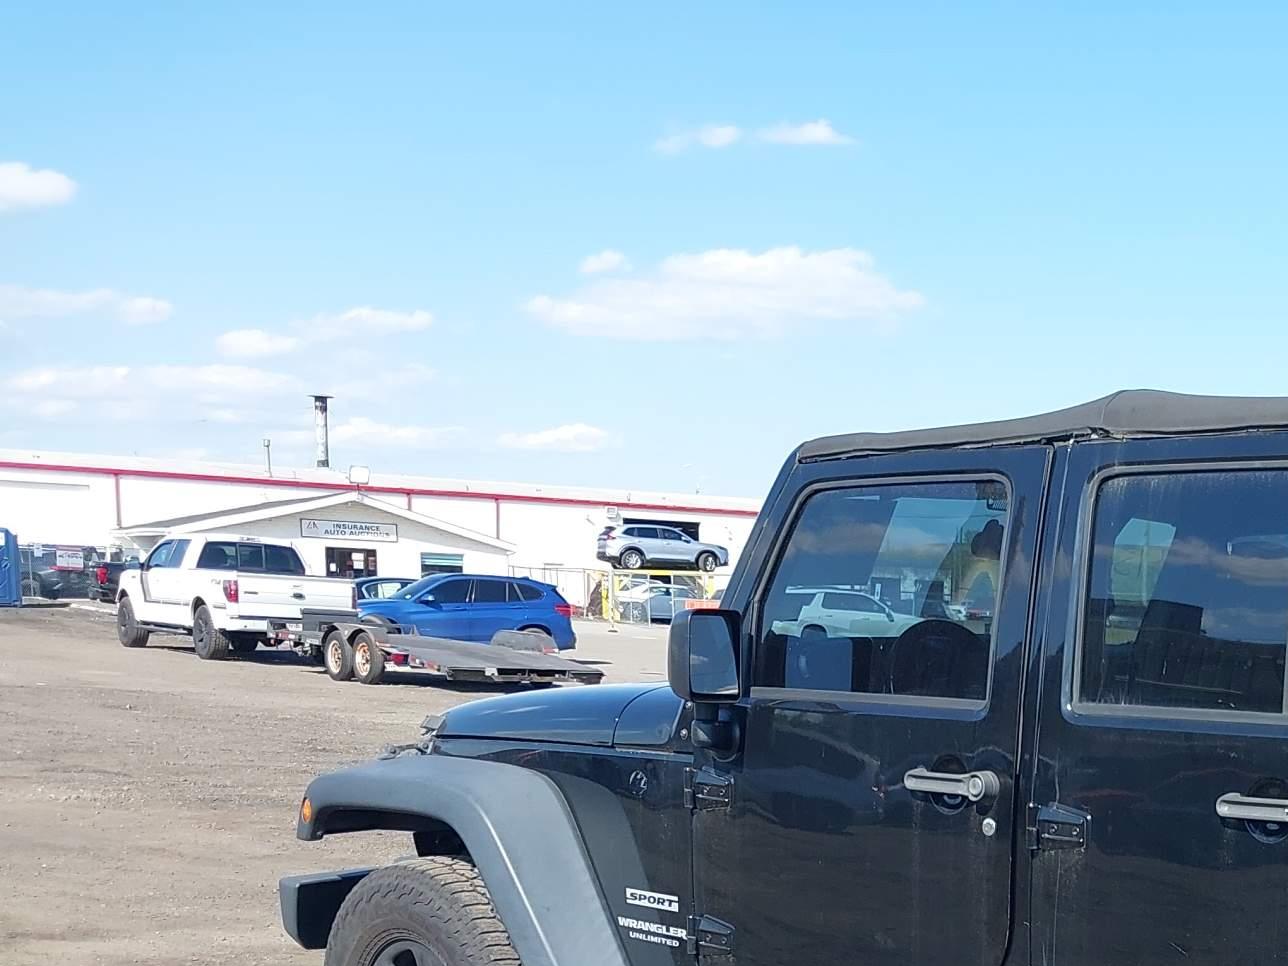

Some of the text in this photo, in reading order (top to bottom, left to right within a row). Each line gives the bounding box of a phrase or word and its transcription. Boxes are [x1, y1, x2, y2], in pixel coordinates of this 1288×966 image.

[333, 523, 380, 531] INSURANCE
[626, 892, 678, 908] SPORT
[617, 916, 688, 940] WRANGLER
[629, 931, 680, 947] UNLIMITED
